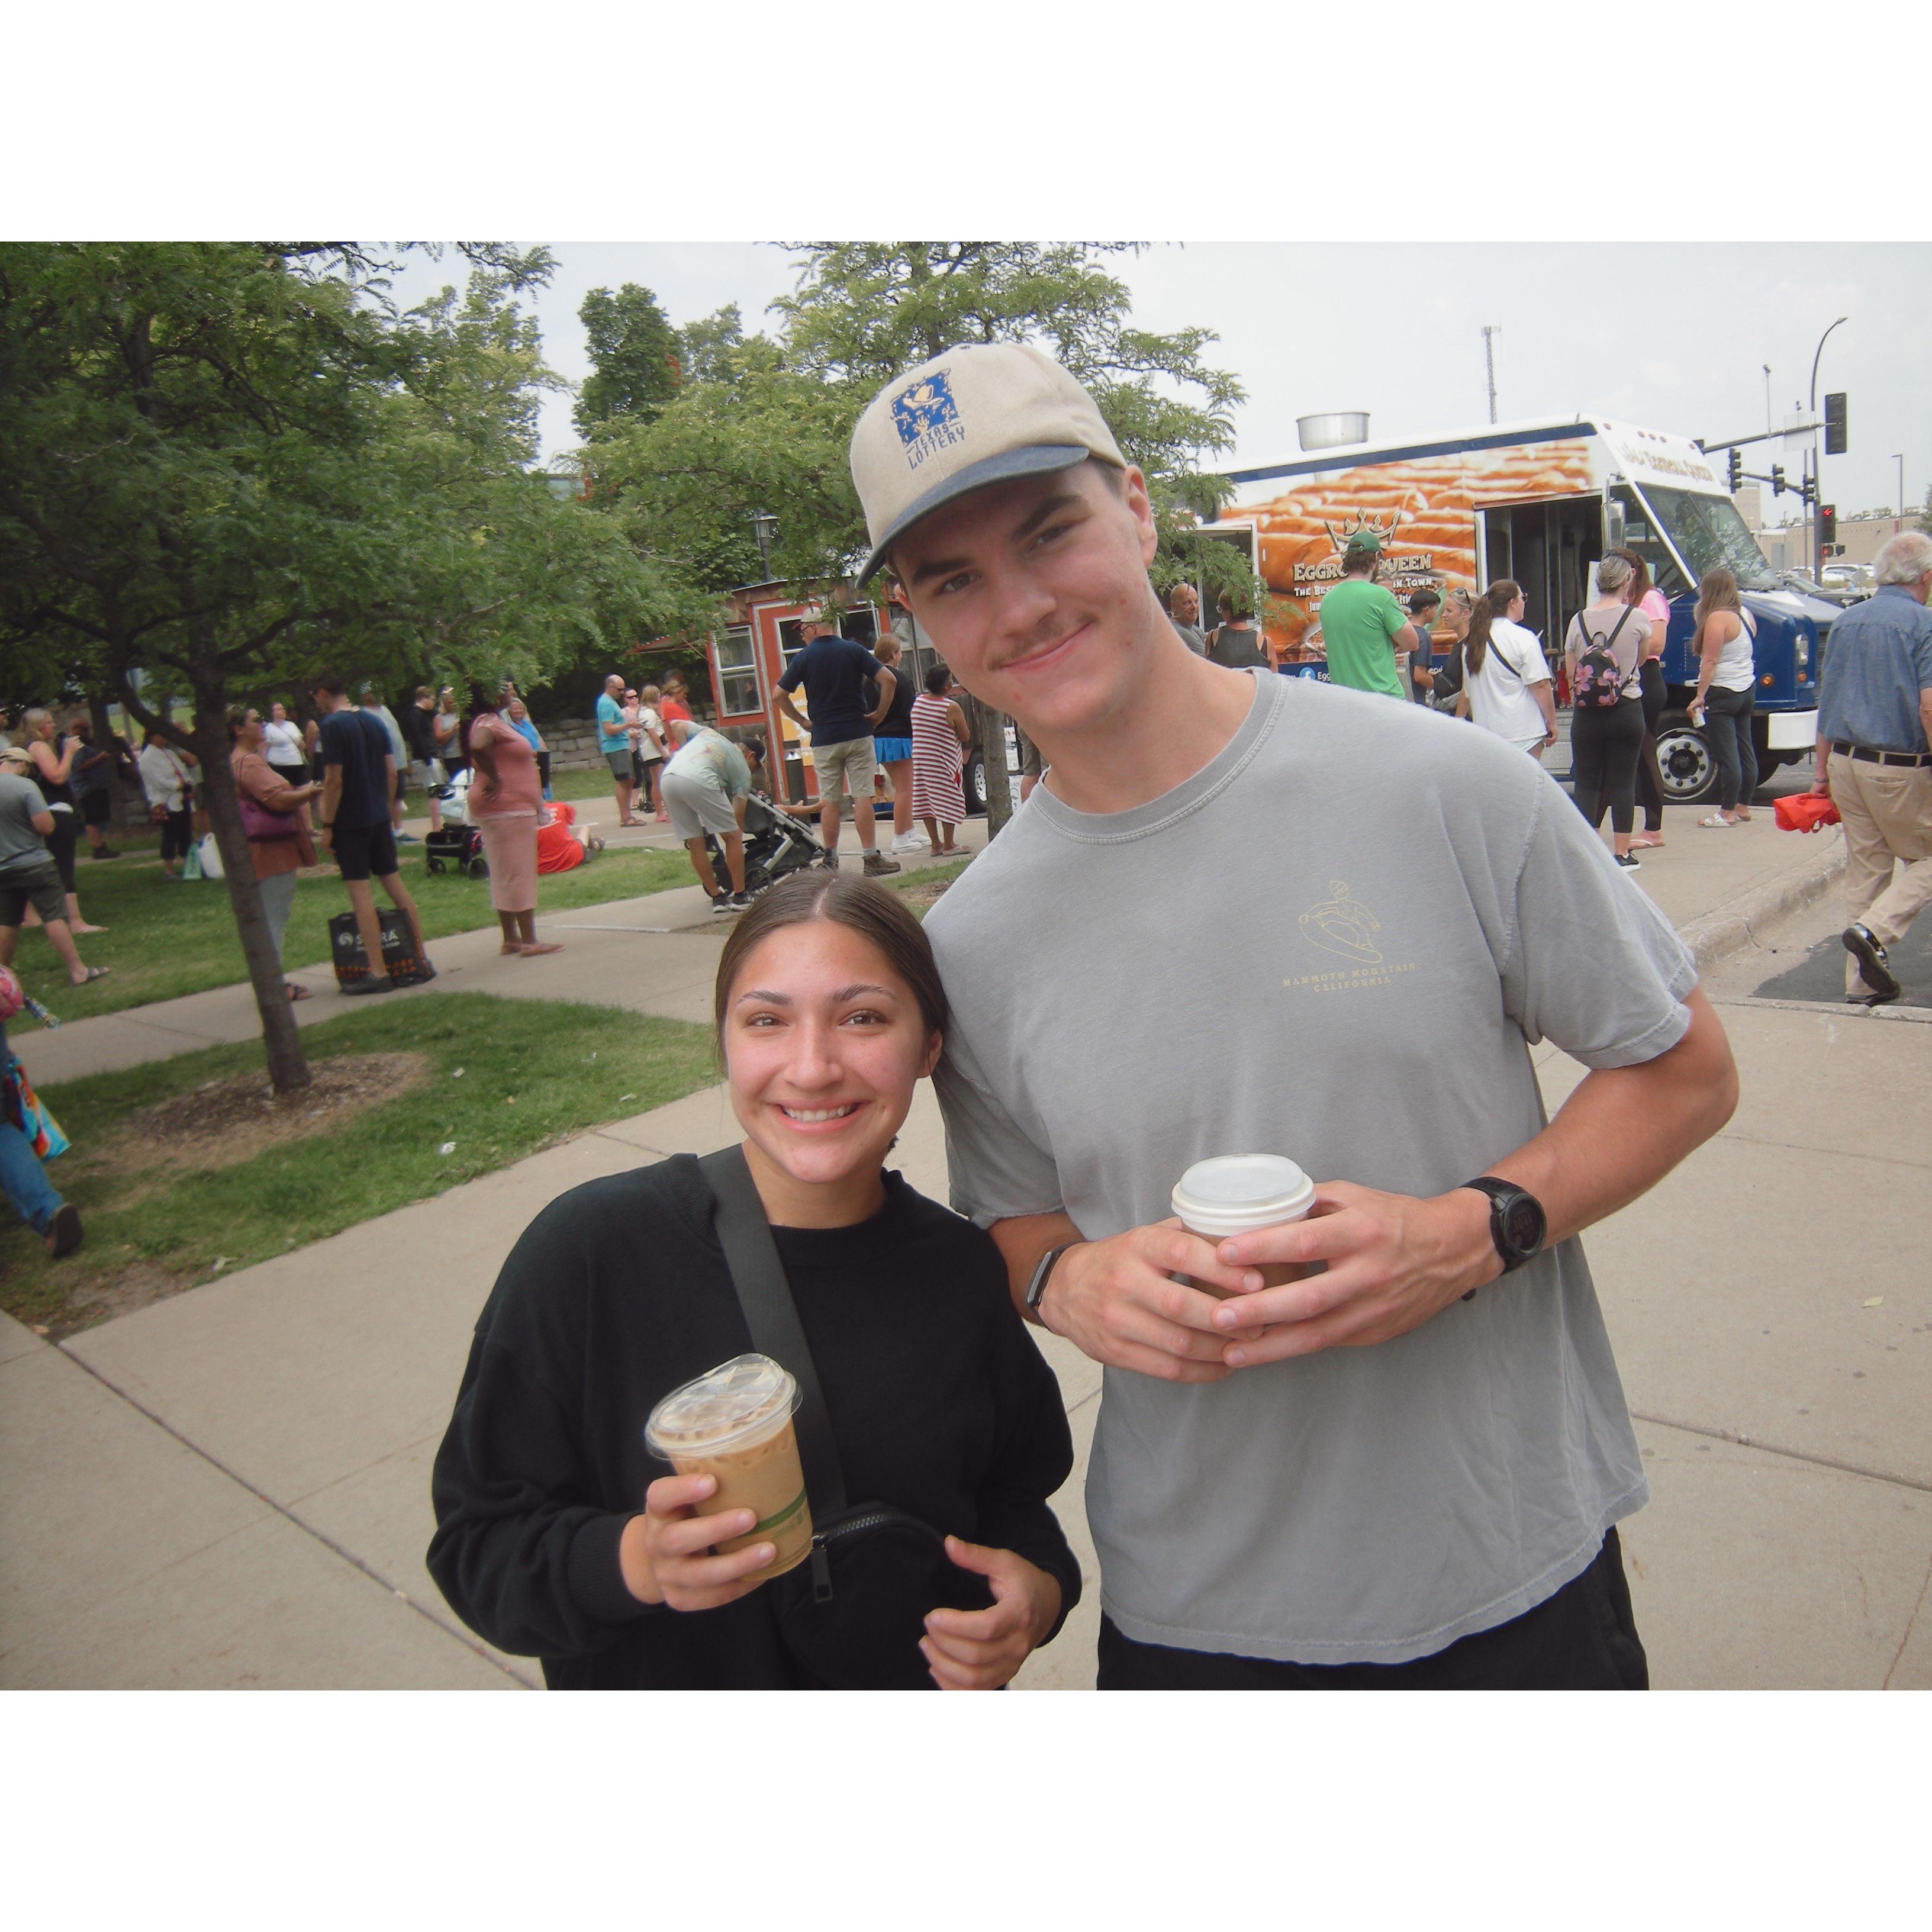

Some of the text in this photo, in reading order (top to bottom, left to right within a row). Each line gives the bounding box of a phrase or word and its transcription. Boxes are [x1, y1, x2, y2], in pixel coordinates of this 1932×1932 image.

[913, 423, 949, 450] TEXAS
[909, 426, 965, 470] LOTTERY
[1294, 563, 1349, 581] EGGRO
[1314, 586, 1335, 596] BES
[1283, 971, 1345, 987] MAMMOTH
[1313, 977, 1391, 992] CALIFORNIA
